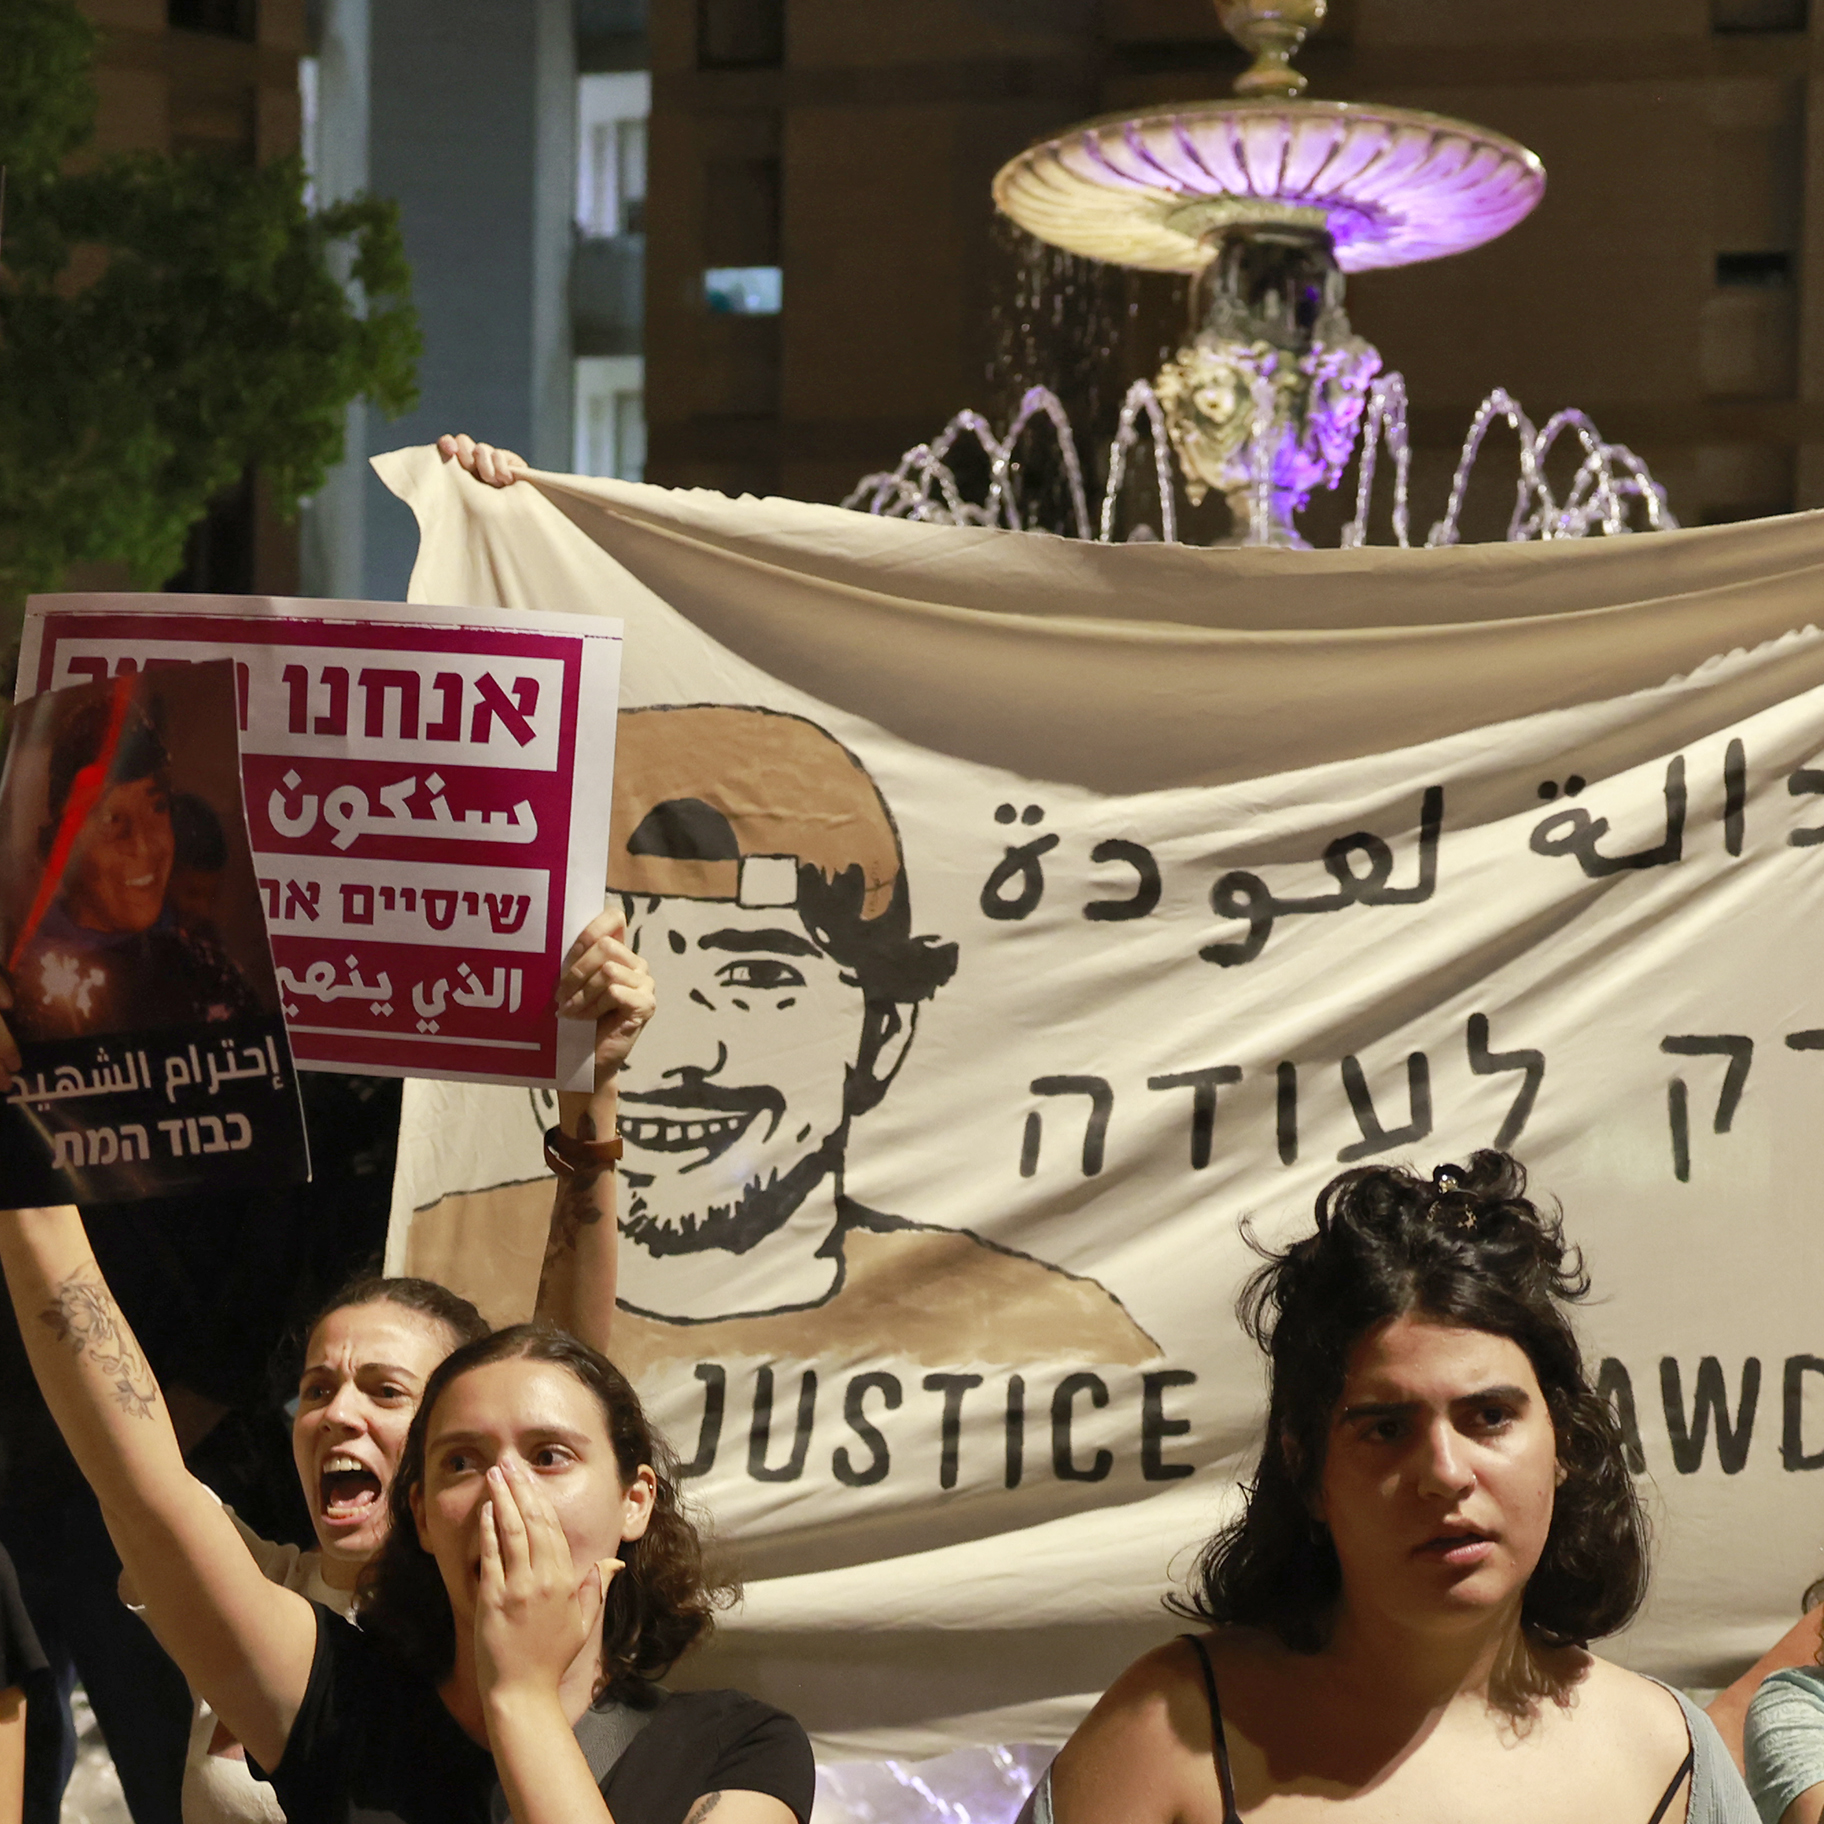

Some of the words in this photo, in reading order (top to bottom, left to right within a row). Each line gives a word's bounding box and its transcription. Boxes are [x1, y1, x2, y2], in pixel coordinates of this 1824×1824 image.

[281, 663, 542, 748] אנחנו
[267, 769, 538, 851] سنكون
[339, 883, 532, 935] שיסיים
[978, 784, 1445, 968] لعودة
[412, 961, 523, 1035] الذي
[5, 1045, 152, 1111] الشهيد
[1018, 1011, 1546, 1179] לעודה
[51, 1126, 150, 1171] המת
[157, 1110, 253, 1157] כבוד
[676, 1362, 1200, 1490] JUSTICE
